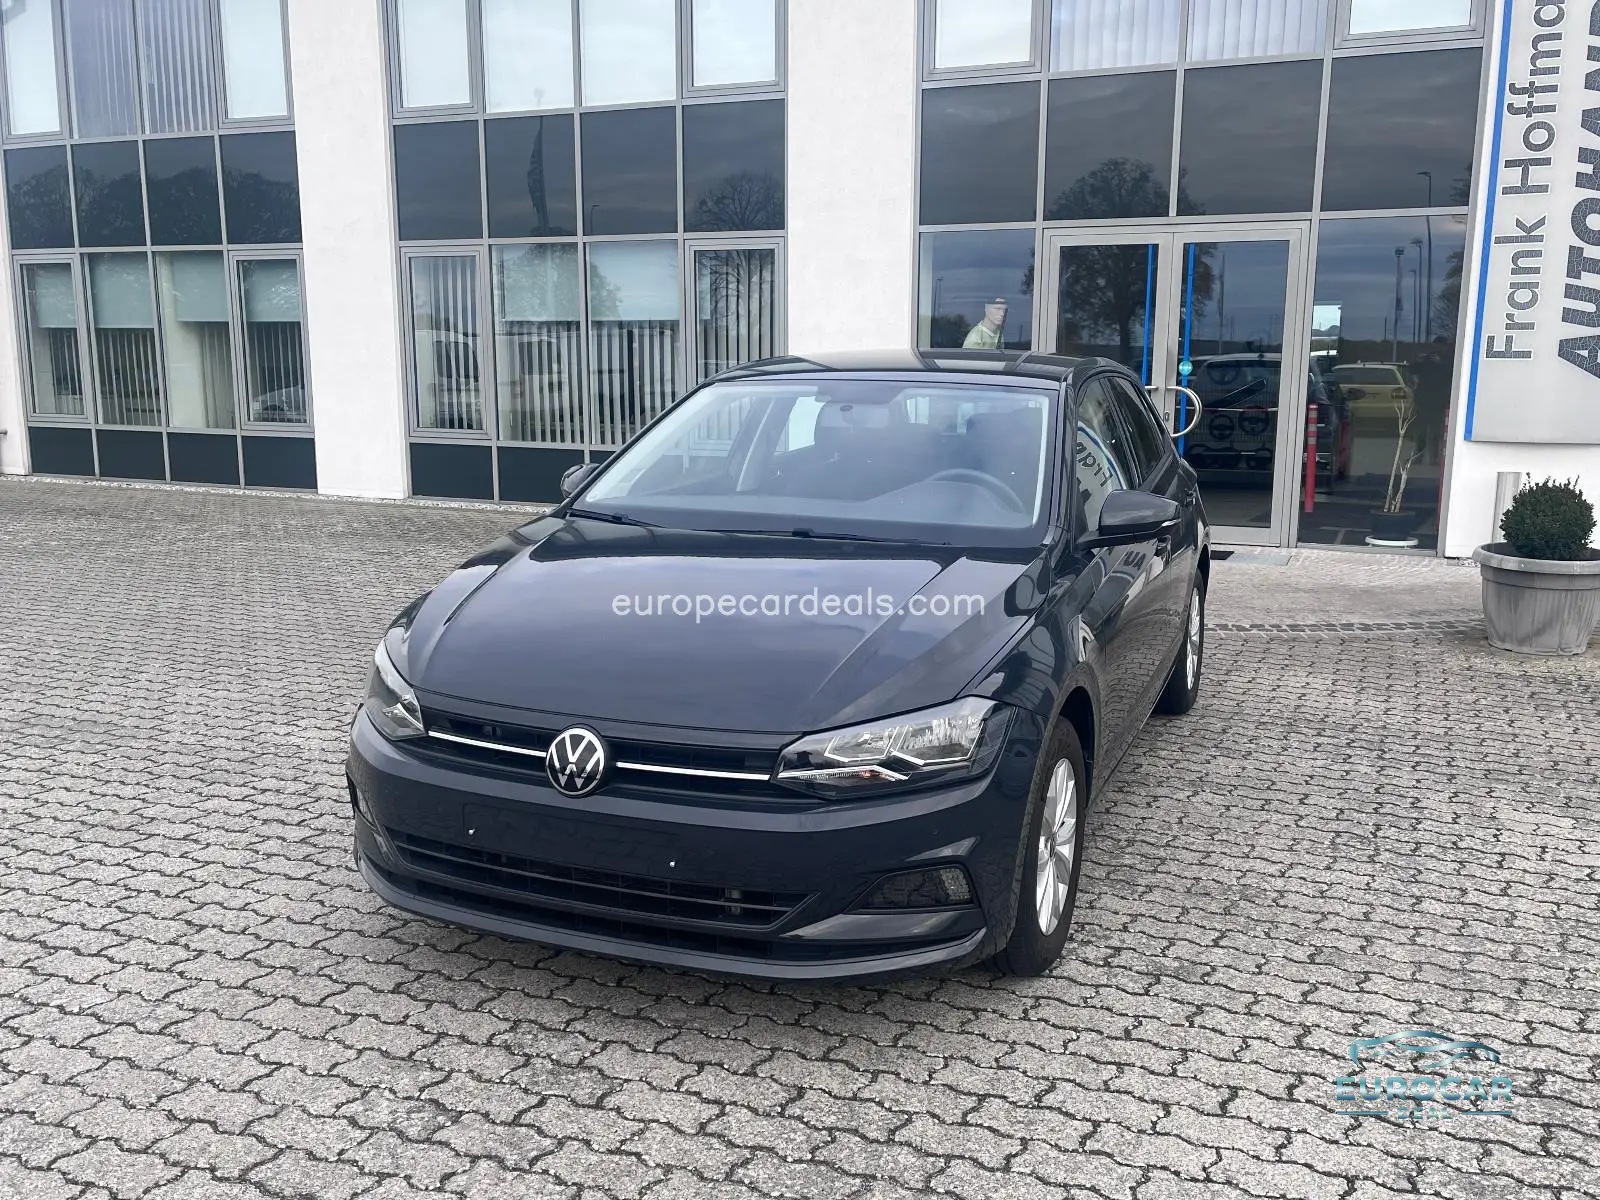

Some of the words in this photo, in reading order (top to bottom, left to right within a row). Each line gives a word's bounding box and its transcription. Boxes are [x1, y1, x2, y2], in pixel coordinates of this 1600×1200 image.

[1501, 0, 1565, 195] Hoffma
[1485, 214, 1547, 359] Frank
[547, 728, 604, 795] VW
